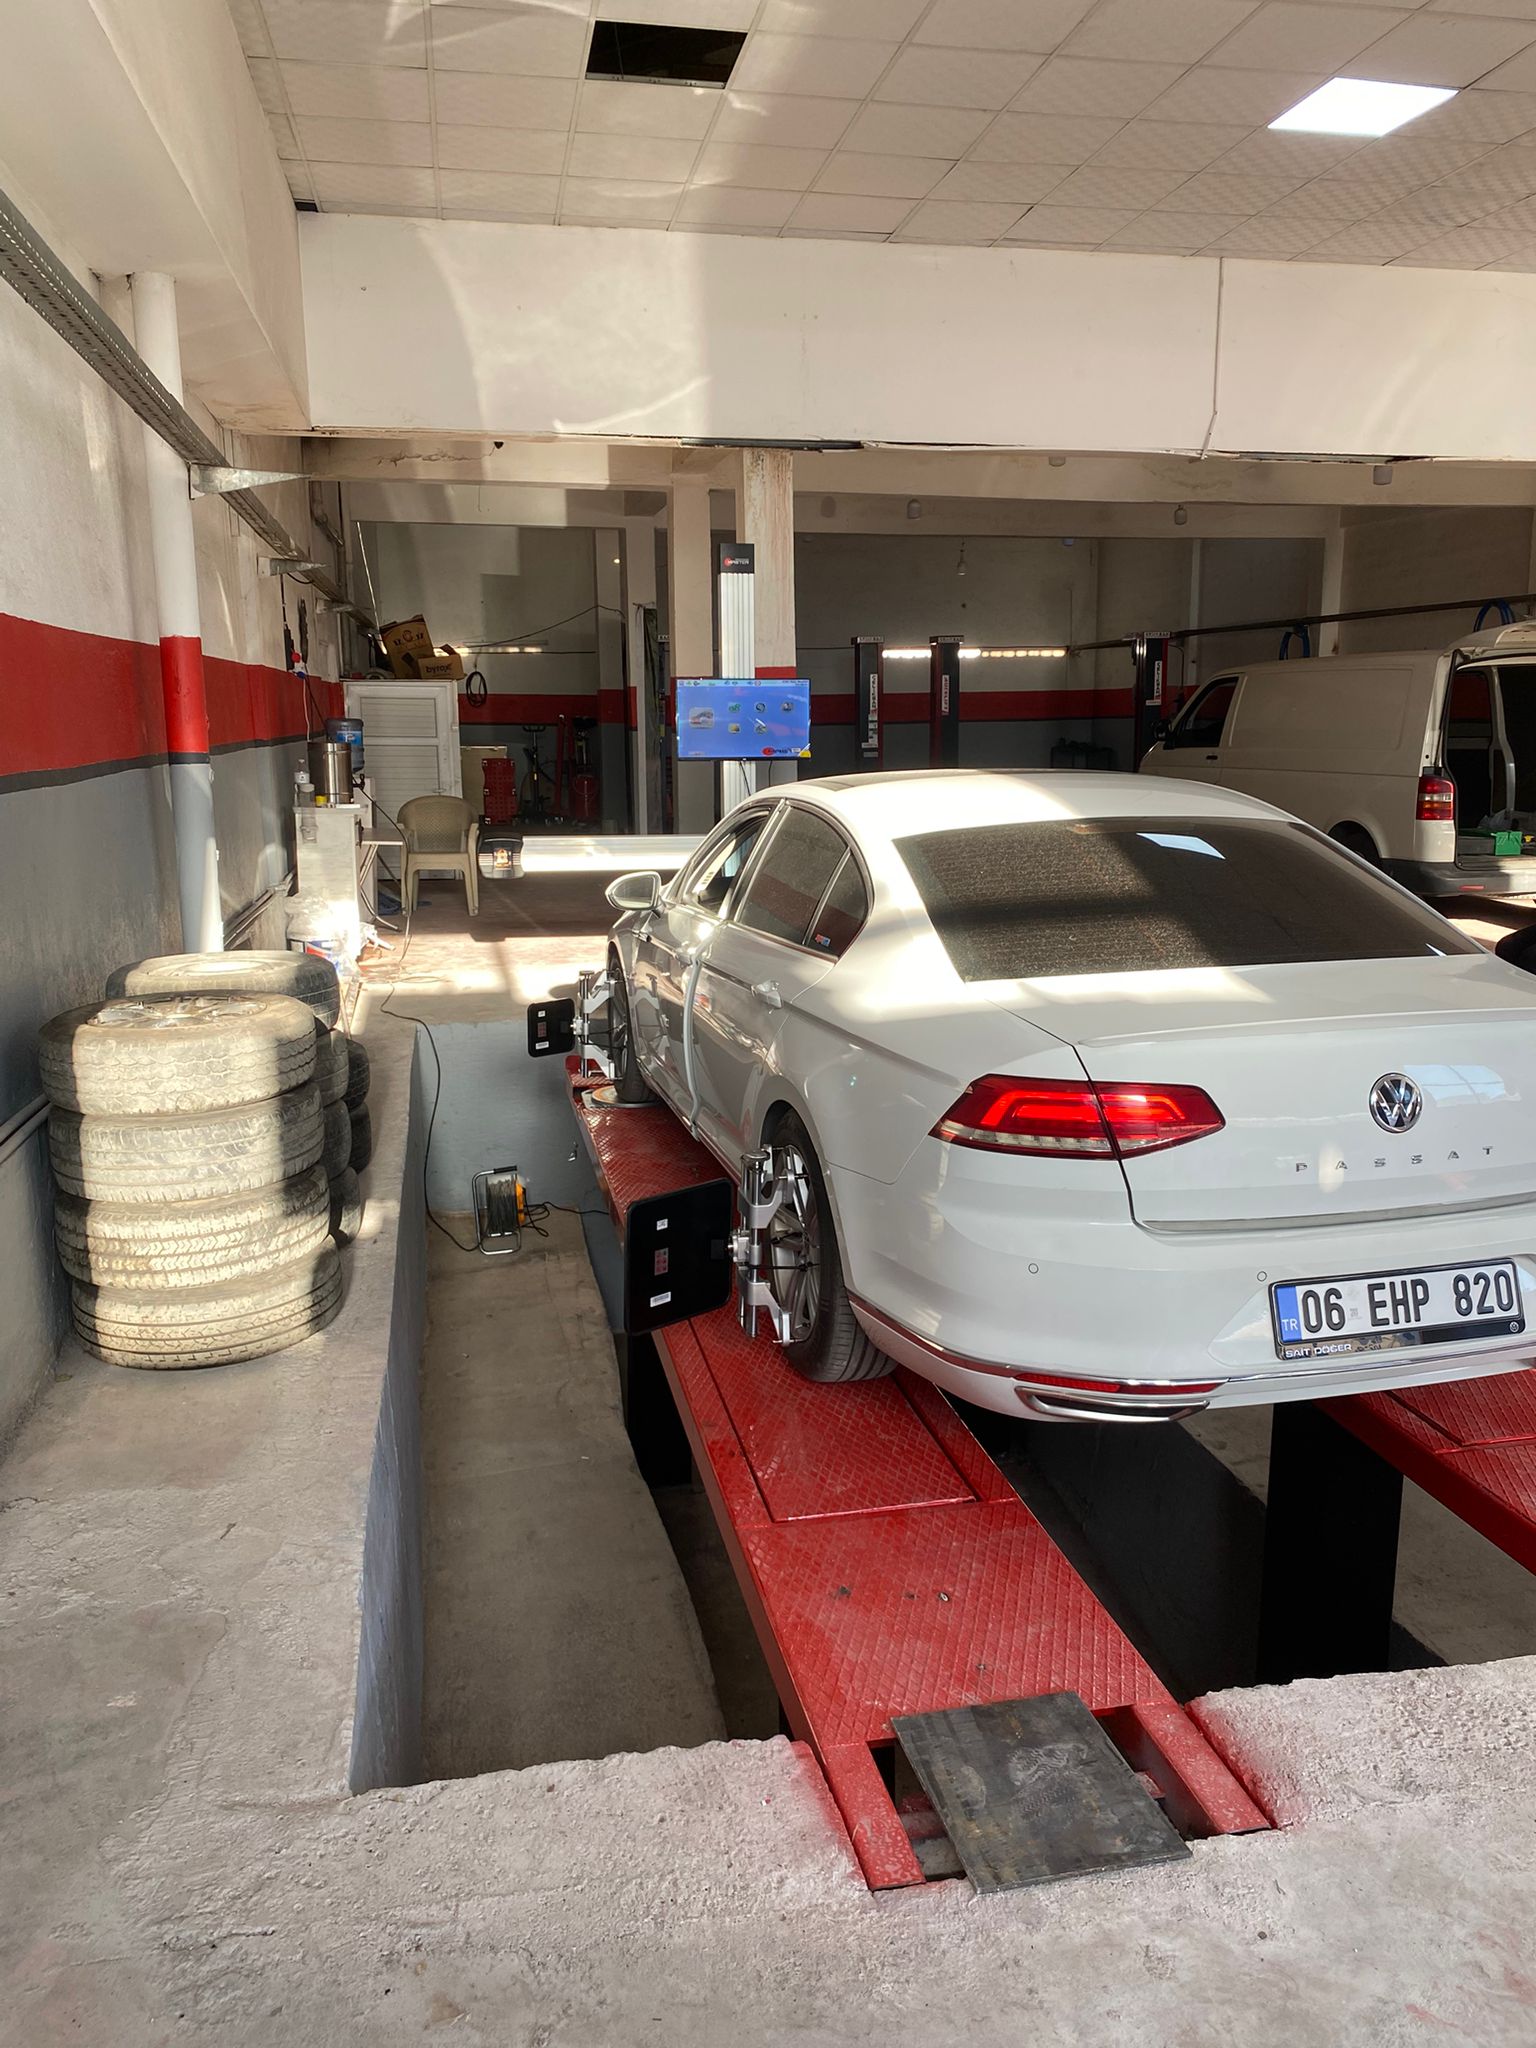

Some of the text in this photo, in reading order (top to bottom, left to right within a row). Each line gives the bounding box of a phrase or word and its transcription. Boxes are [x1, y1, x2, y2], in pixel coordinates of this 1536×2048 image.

[1295, 1146, 1494, 1172] PASSAT
[1301, 1269, 1515, 1334] 06 EHP 820
[1281, 1318, 1299, 1331] TR
